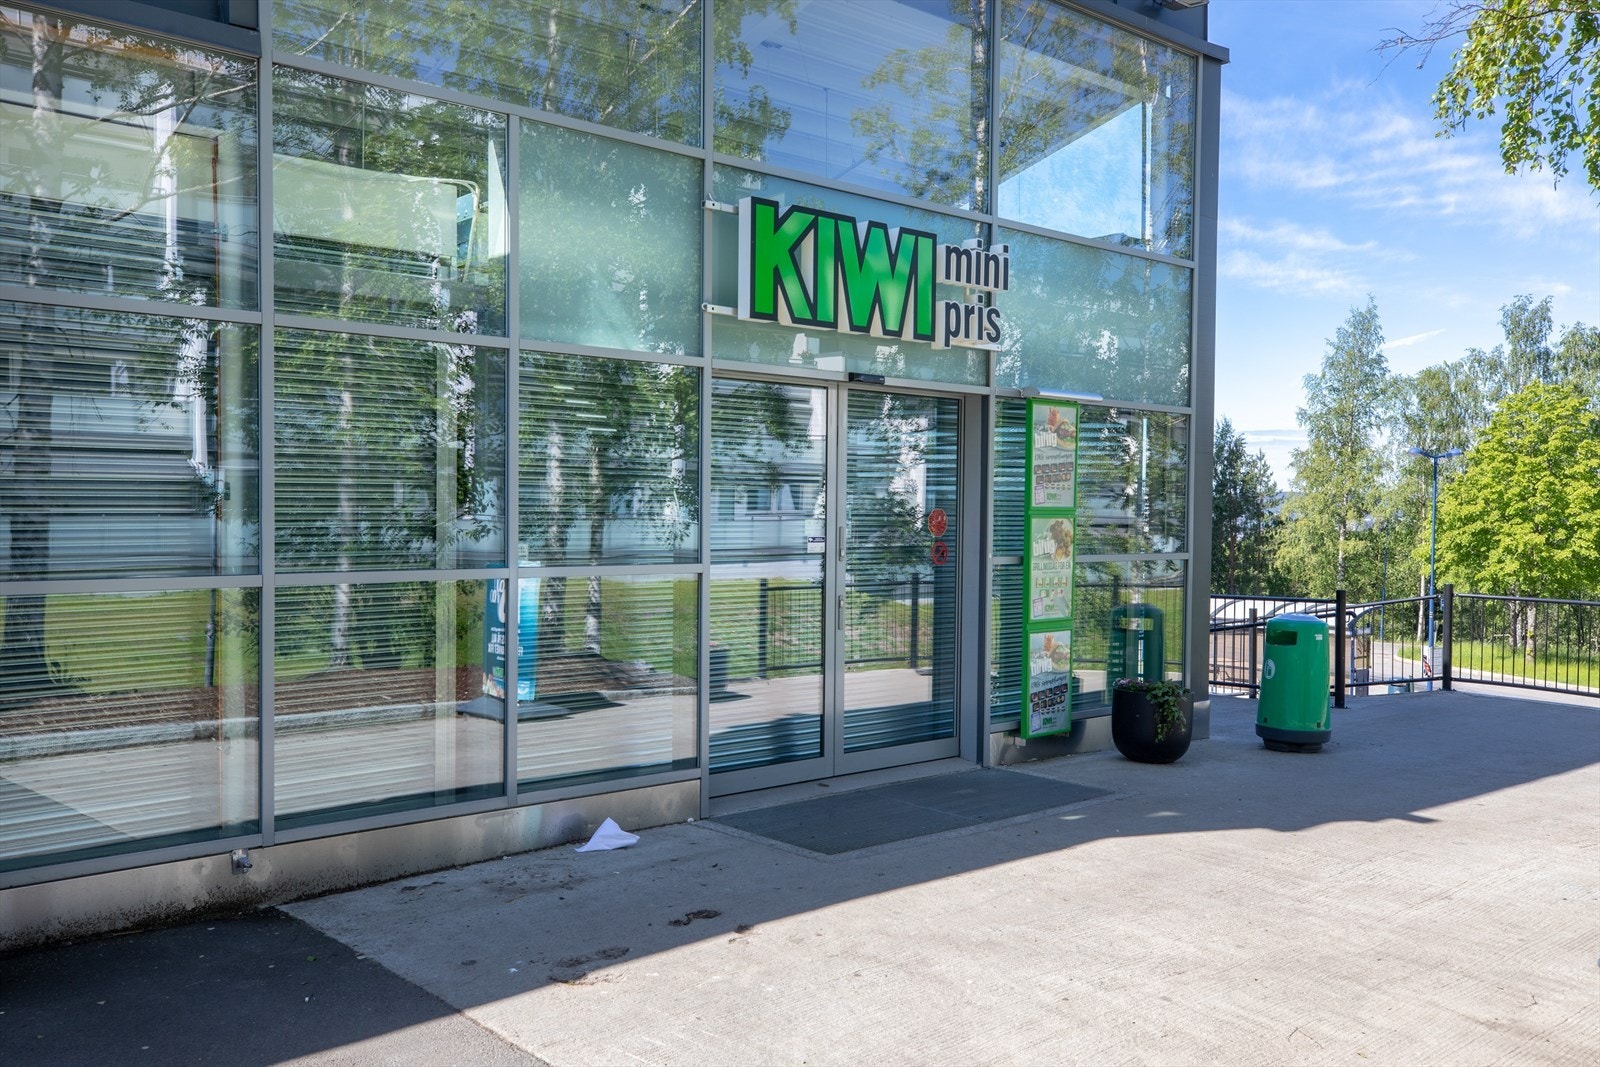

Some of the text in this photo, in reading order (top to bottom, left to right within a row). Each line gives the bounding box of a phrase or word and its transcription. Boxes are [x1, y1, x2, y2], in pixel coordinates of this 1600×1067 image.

[750, 196, 937, 342] KIWI
[944, 239, 1009, 291] mini
[944, 293, 1000, 348] pris
